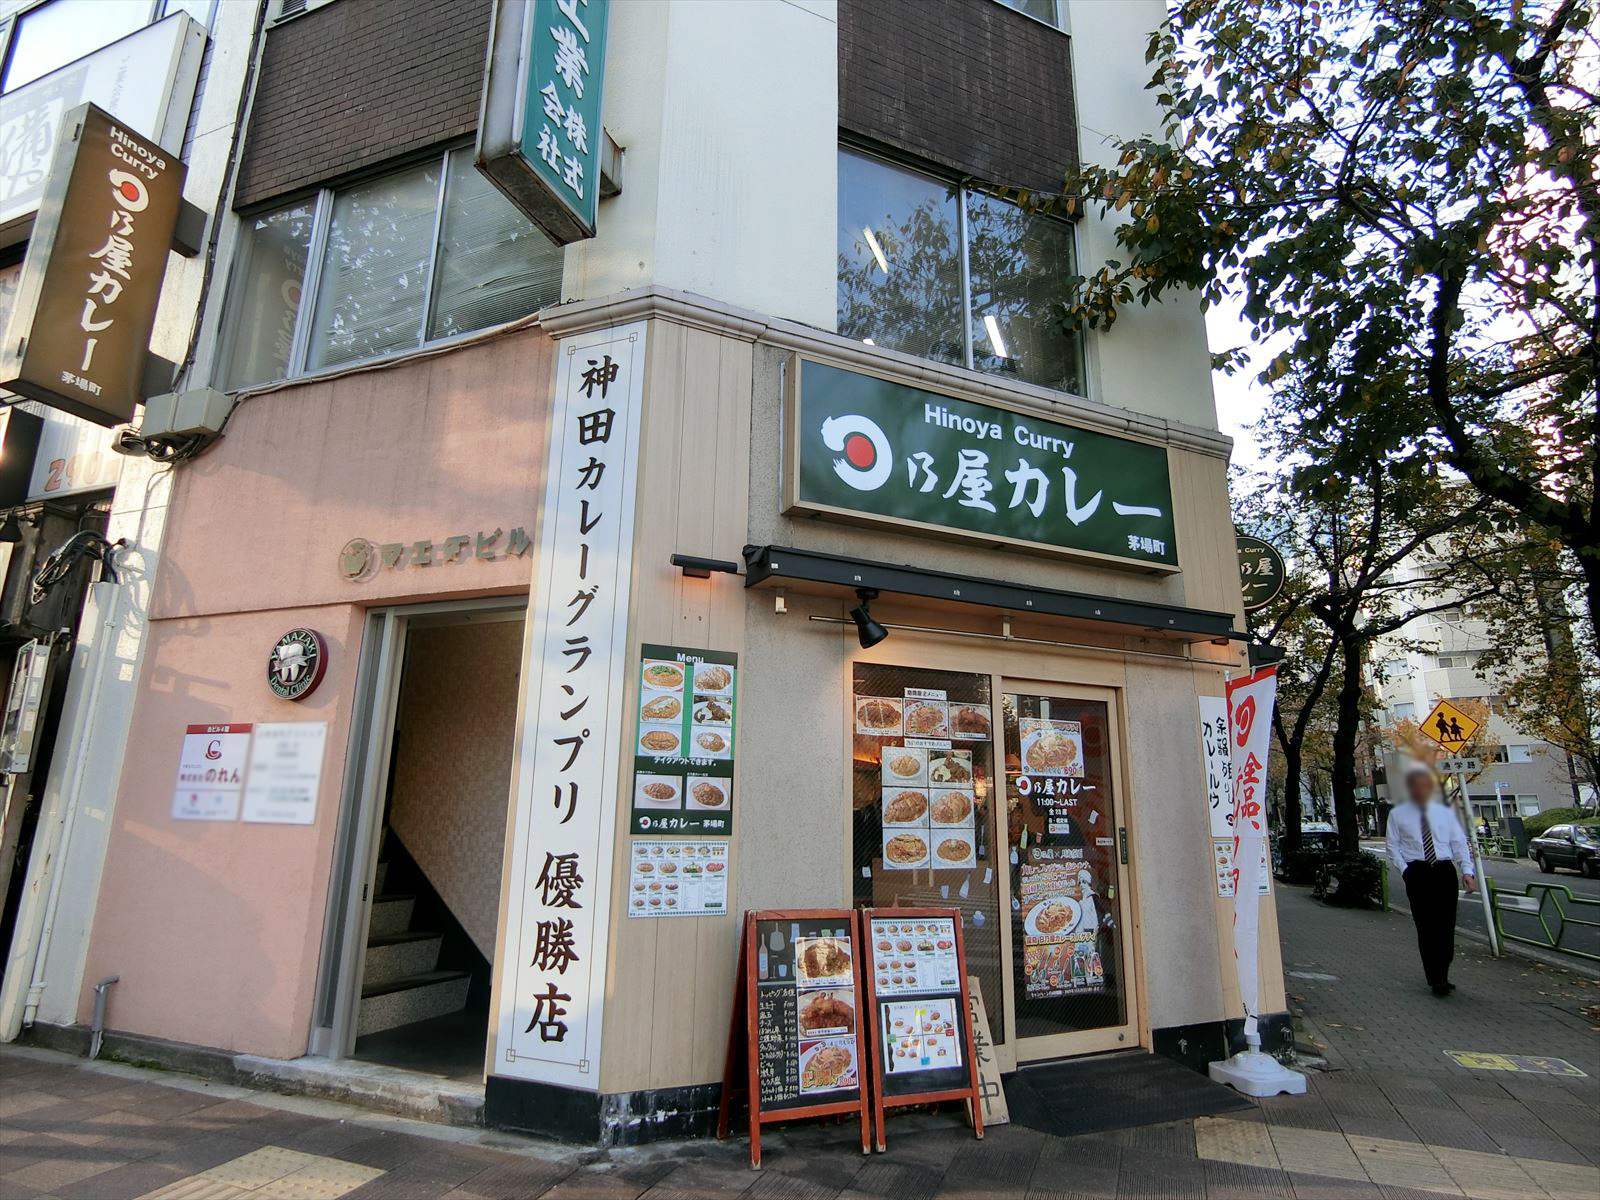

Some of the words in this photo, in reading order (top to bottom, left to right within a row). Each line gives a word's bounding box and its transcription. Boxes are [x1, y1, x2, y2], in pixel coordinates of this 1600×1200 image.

[110, 126, 167, 170] Hinoya
[111, 143, 159, 180] Curry
[61, 370, 103, 397] 茅場町
[924, 403, 1003, 440] Hinoya
[1014, 425, 1075, 460] Curry
[381, 527, 531, 569] マエダビル
[1127, 533, 1165, 556] 茅場町
[553, 355, 619, 825] 神田カレーグランプリ
[676, 652, 704, 663] Menu
[270, 676, 290, 697] Dental
[290, 674, 311, 695] Clinic
[1202, 721, 1220, 809] カレールウ
[1442, 760, 1476, 771] 通学路
[525, 851, 585, 1044] 優勝店
